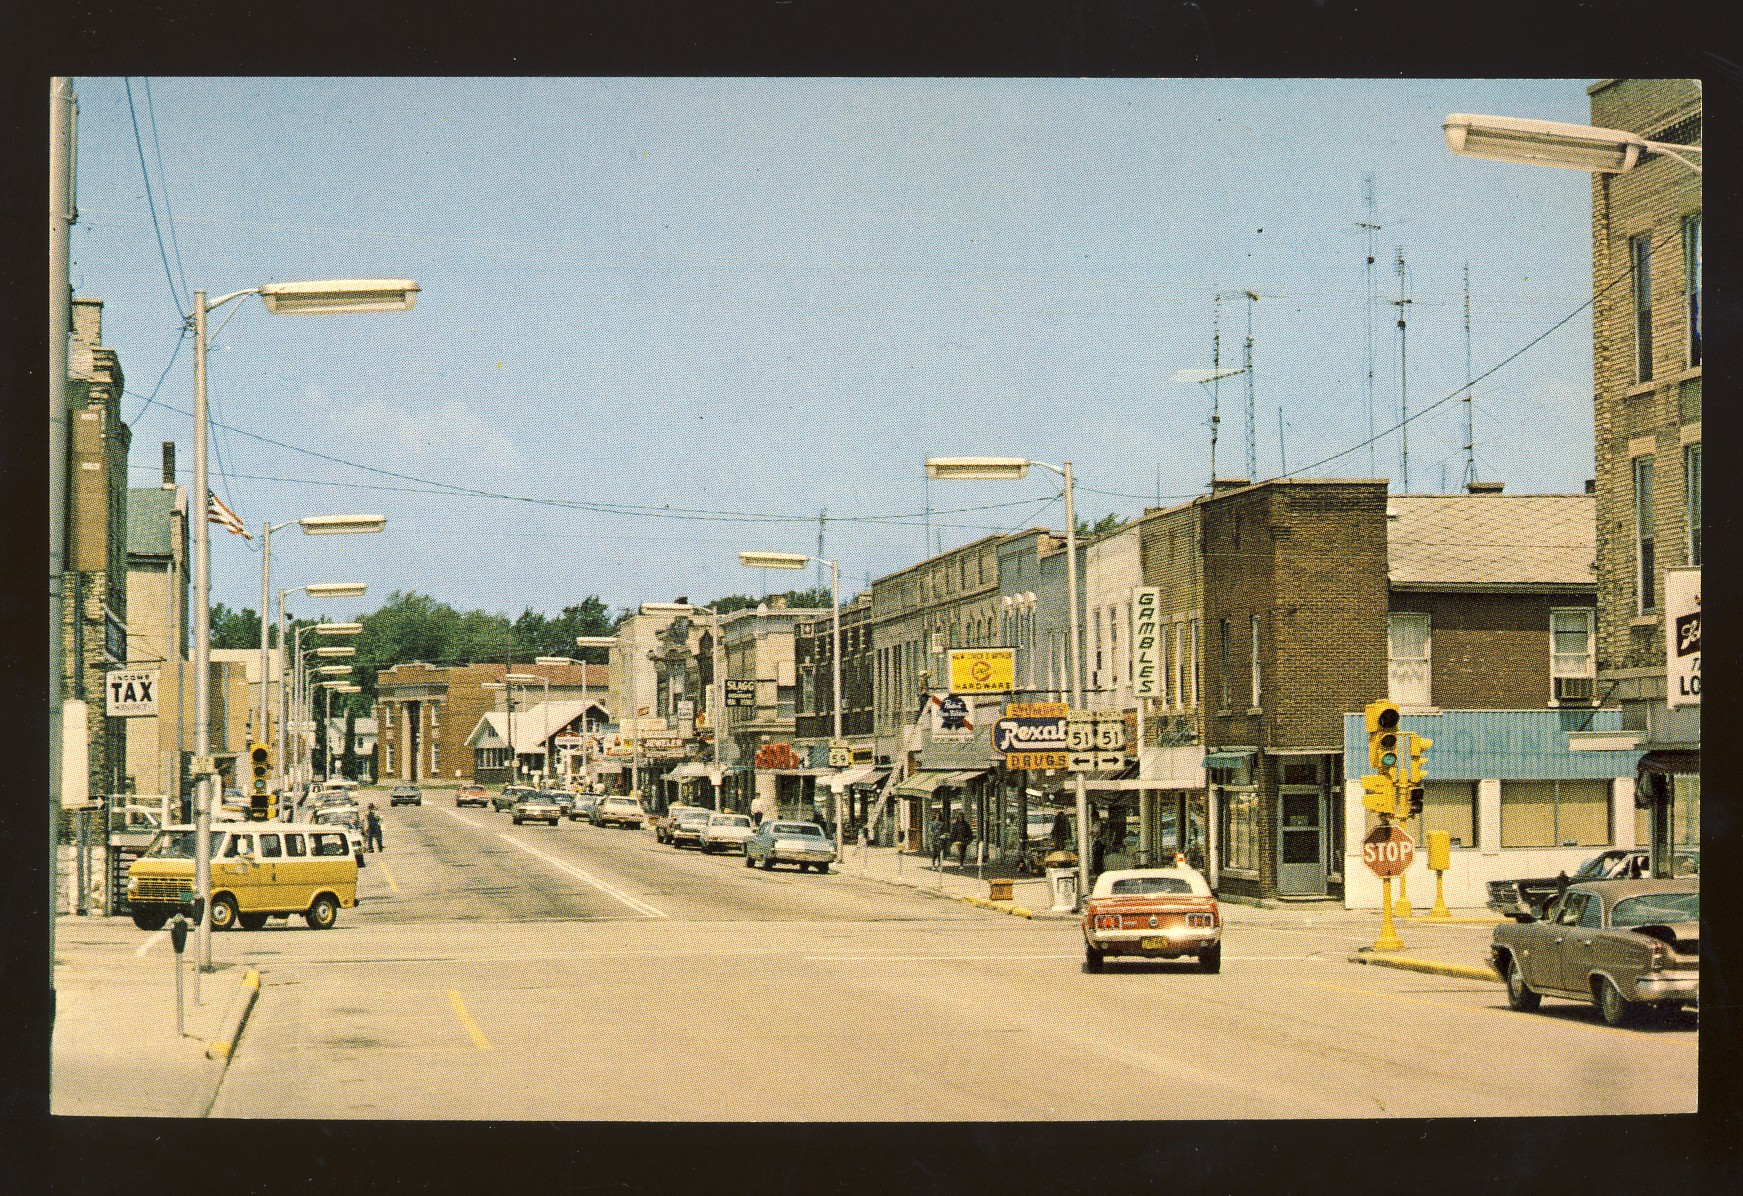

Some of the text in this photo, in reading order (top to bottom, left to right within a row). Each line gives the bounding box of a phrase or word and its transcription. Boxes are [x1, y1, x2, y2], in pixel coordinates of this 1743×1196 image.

[1138, 592, 1155, 693] GAMBLES
[113, 673, 150, 681] INCOME
[111, 681, 153, 703] TAX
[954, 681, 1012, 690] HARDWARE
[999, 720, 1068, 750] Rexal
[1072, 731, 1090, 746] 51
[1102, 731, 1119, 745] 51
[831, 754, 846, 765] 59
[1011, 755, 1067, 767] DRUGS
[1364, 842, 1412, 863] STOP
